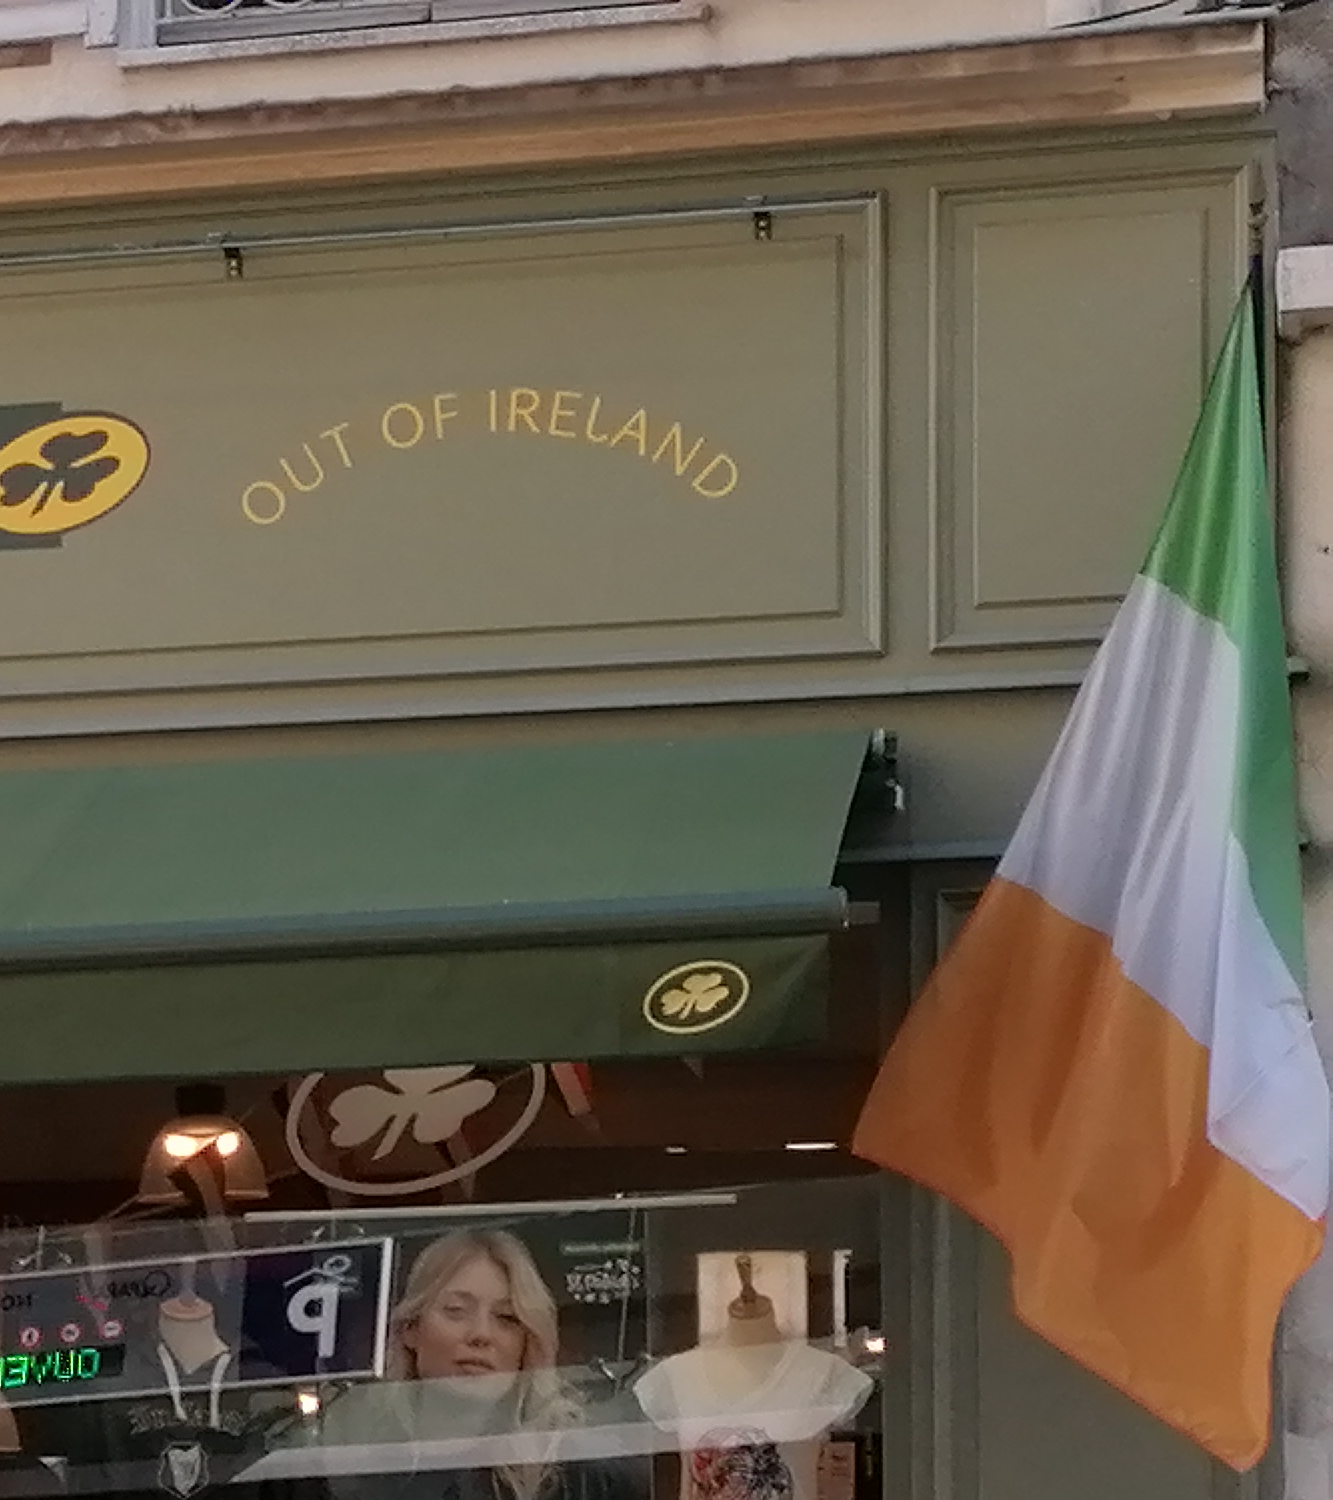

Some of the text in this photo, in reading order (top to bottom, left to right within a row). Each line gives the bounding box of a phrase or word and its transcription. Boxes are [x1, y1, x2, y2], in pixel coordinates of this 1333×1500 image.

[242, 387, 739, 525] OUT OF IRELAND
